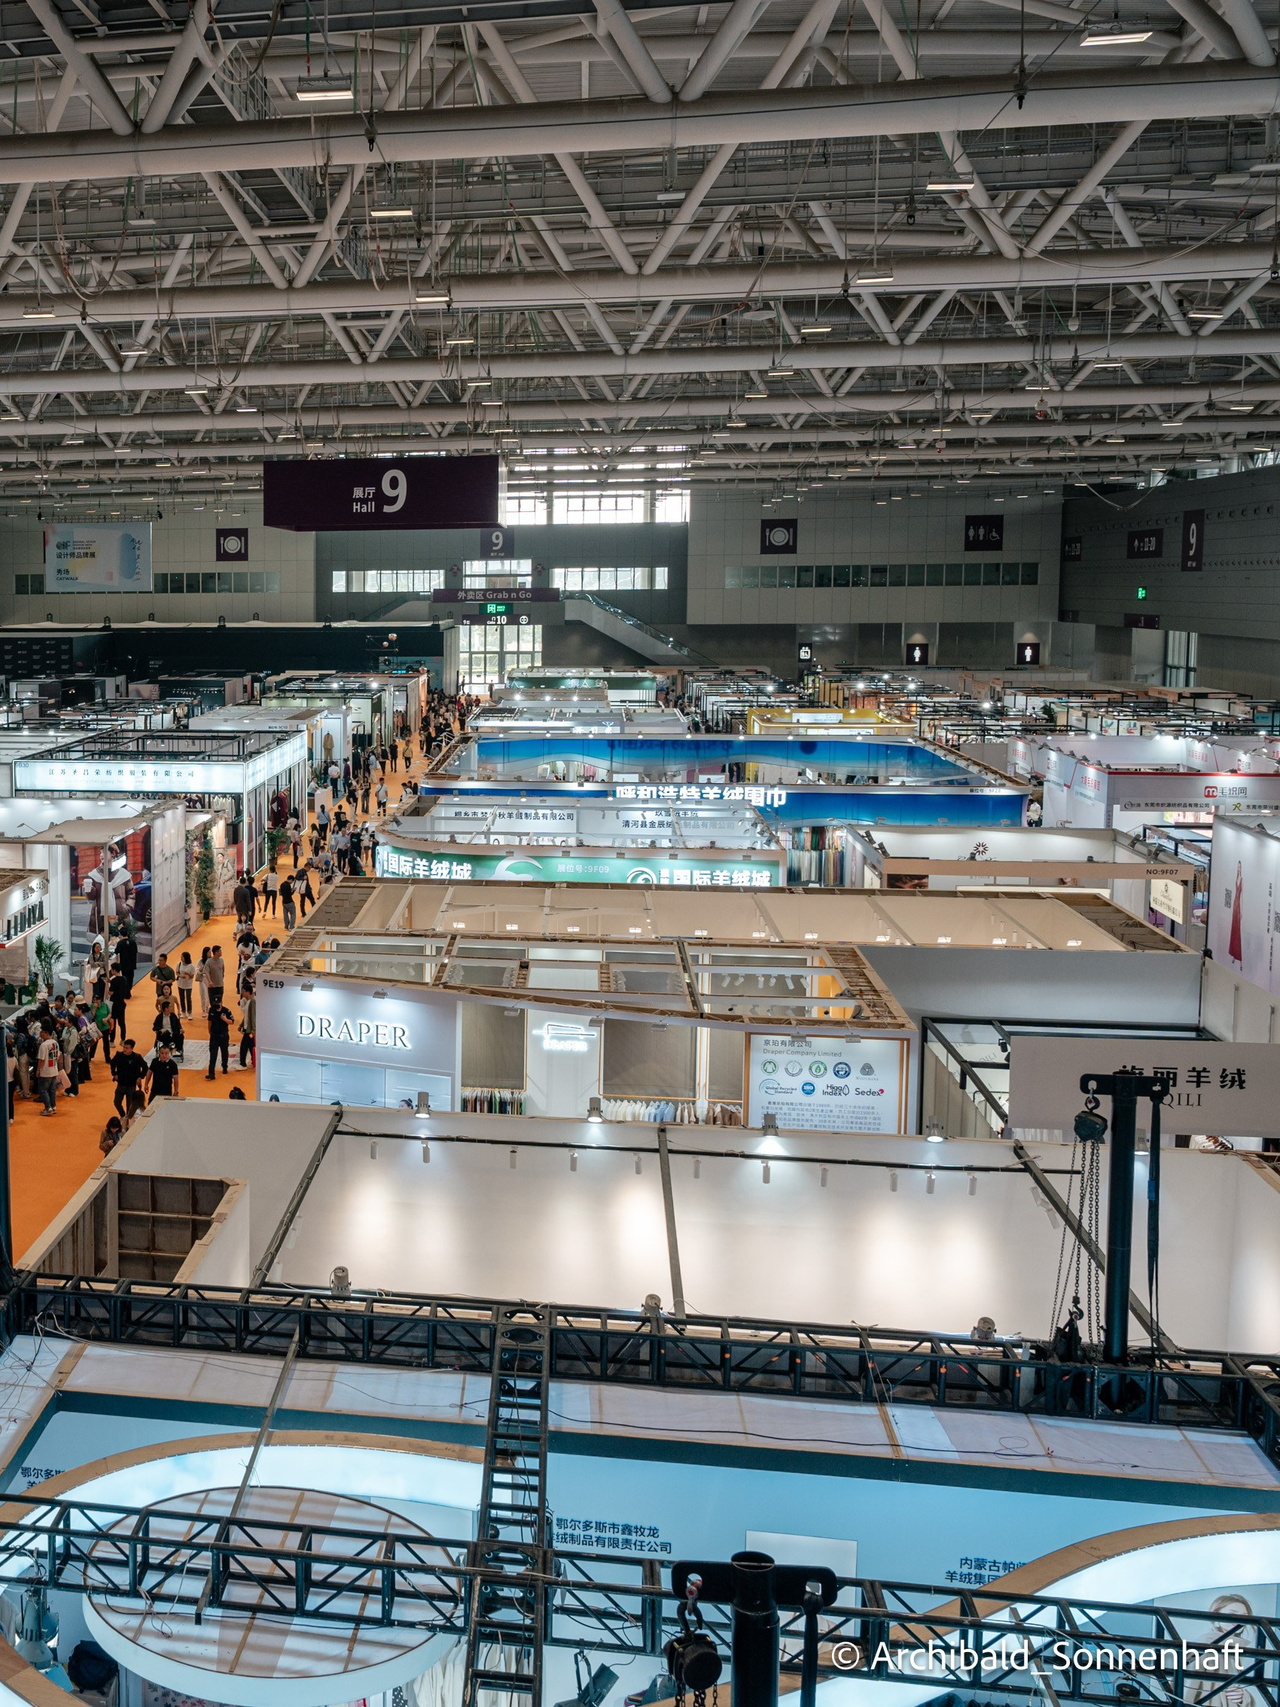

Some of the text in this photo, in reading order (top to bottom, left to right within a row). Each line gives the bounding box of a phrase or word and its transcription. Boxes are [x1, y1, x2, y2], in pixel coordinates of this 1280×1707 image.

[352, 468, 408, 513] Hall 9
[352, 486, 376, 499] 展厅
[492, 531, 504, 550] 9
[1189, 523, 1197, 556] 9
[56, 551, 96, 559] 设计师品牌展
[457, 590, 484, 600] 外卖区
[486, 591, 508, 599] Grab
[519, 590, 532, 599] Go
[497, 615, 507, 624] 10
[263, 978, 285, 989] 9E19
[297, 1014, 411, 1050] DRAPER
[763, 1048, 842, 1058] Draper Company Limited
[854, 1088, 882, 1097] Sedex
[556, 1517, 660, 1539] 鄂尔多斯市鑫牧龙
[553, 1531, 672, 1555] 绒制品有限责任公司
